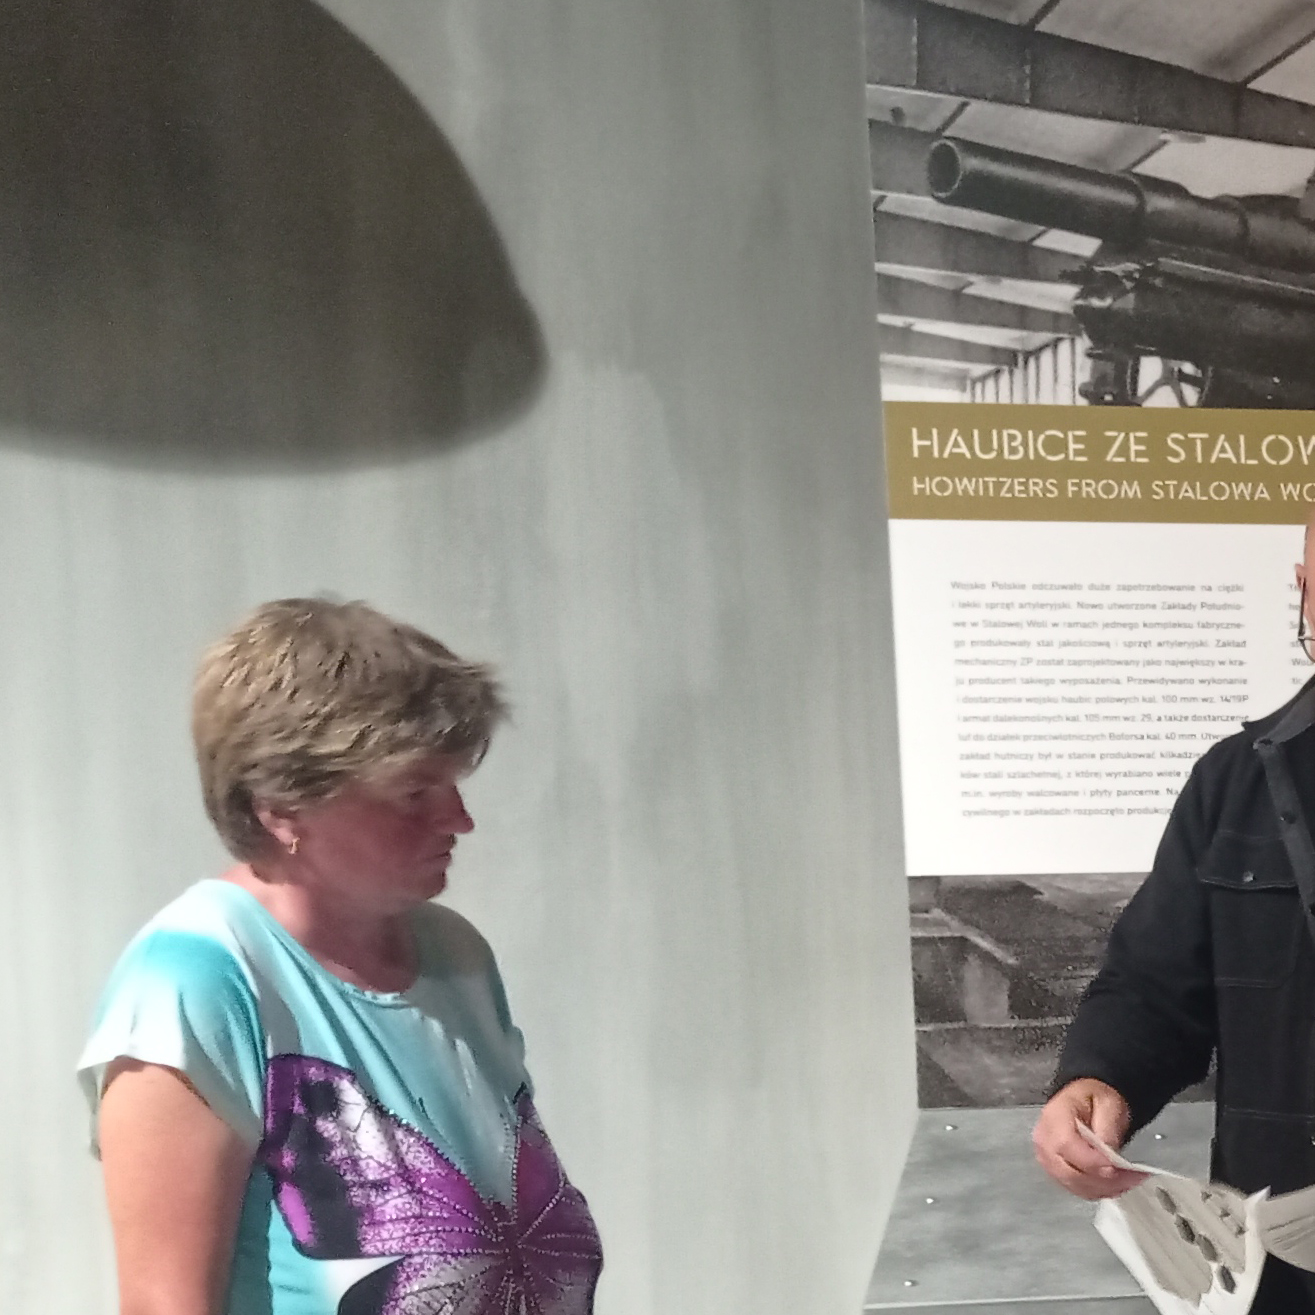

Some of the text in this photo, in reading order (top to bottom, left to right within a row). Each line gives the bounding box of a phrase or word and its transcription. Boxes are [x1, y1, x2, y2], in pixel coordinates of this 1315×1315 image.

[911, 427, 1089, 462] HAUBICE
[1103, 430, 1150, 463] ZE
[912, 476, 1059, 498] HOWITZERS
[1067, 478, 1142, 499] FROM
[1151, 480, 1271, 501] STALOWA
